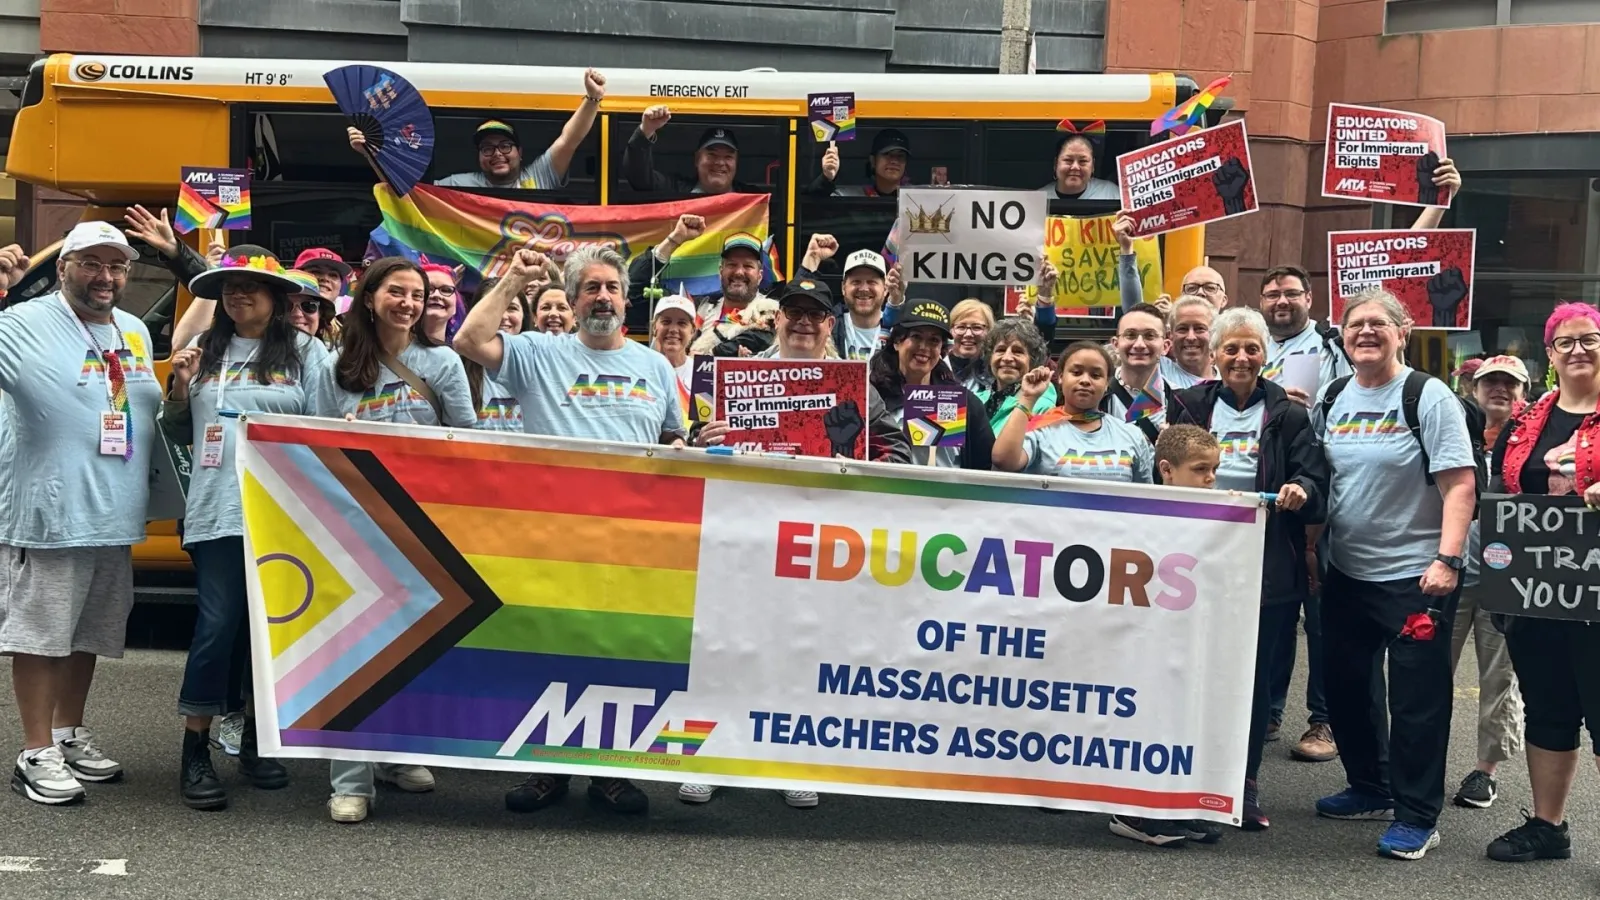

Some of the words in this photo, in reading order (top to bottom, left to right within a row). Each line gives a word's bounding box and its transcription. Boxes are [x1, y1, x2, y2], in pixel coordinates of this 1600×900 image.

[110, 65, 194, 81] COLLINS
[245, 72, 264, 85] HT
[650, 84, 720, 97] EMERGENCY
[725, 86, 749, 98] EXIT
[810, 97, 831, 106] MTA
[1336, 116, 1418, 130] EDUCATORS
[1336, 129, 1387, 140] UNITED
[1125, 138, 1206, 175] EDUCATORS
[1338, 142, 1359, 152] For
[1361, 143, 1424, 155] Immigrant
[1338, 156, 1378, 168] Rights
[185, 172, 216, 183] MTA
[1127, 161, 1176, 186] UNITED
[1131, 184, 1151, 197] For
[1152, 160, 1217, 188] Immigrant
[1335, 178, 1367, 191] MTA
[1133, 190, 1173, 209] Rights
[971, 200, 1026, 230] NO
[1138, 214, 1169, 232] MTA
[1336, 237, 1428, 255] EDUCATORS
[853, 252, 878, 262] PRIDE
[1337, 253, 1390, 268] UNITED
[913, 251, 1035, 282] KINGS
[1340, 270, 1360, 281] For
[1362, 264, 1435, 279] Immigrant
[911, 304, 925, 316] LOS
[920, 311, 942, 321] COUNTY
[724, 367, 823, 384] EDUCATORS
[564, 374, 657, 402] MTA
[725, 384, 785, 398] UNITED
[907, 390, 936, 400] MTA
[728, 400, 752, 412] For
[755, 396, 831, 411] Immigrant
[729, 416, 777, 430] Rights
[1330, 409, 1410, 437] MTA
[1497, 501, 1600, 535] PROT
[775, 520, 1198, 611] EDUCATORS
[917, 620, 966, 652] OF
[977, 624, 1046, 659] THE
[818, 663, 1137, 718] MASSACHUSETTS
[495, 681, 718, 757] MTA
[749, 711, 939, 755] TEACHERS
[947, 727, 1193, 775] ASSOCIATION
[634, 756, 681, 767] Association
